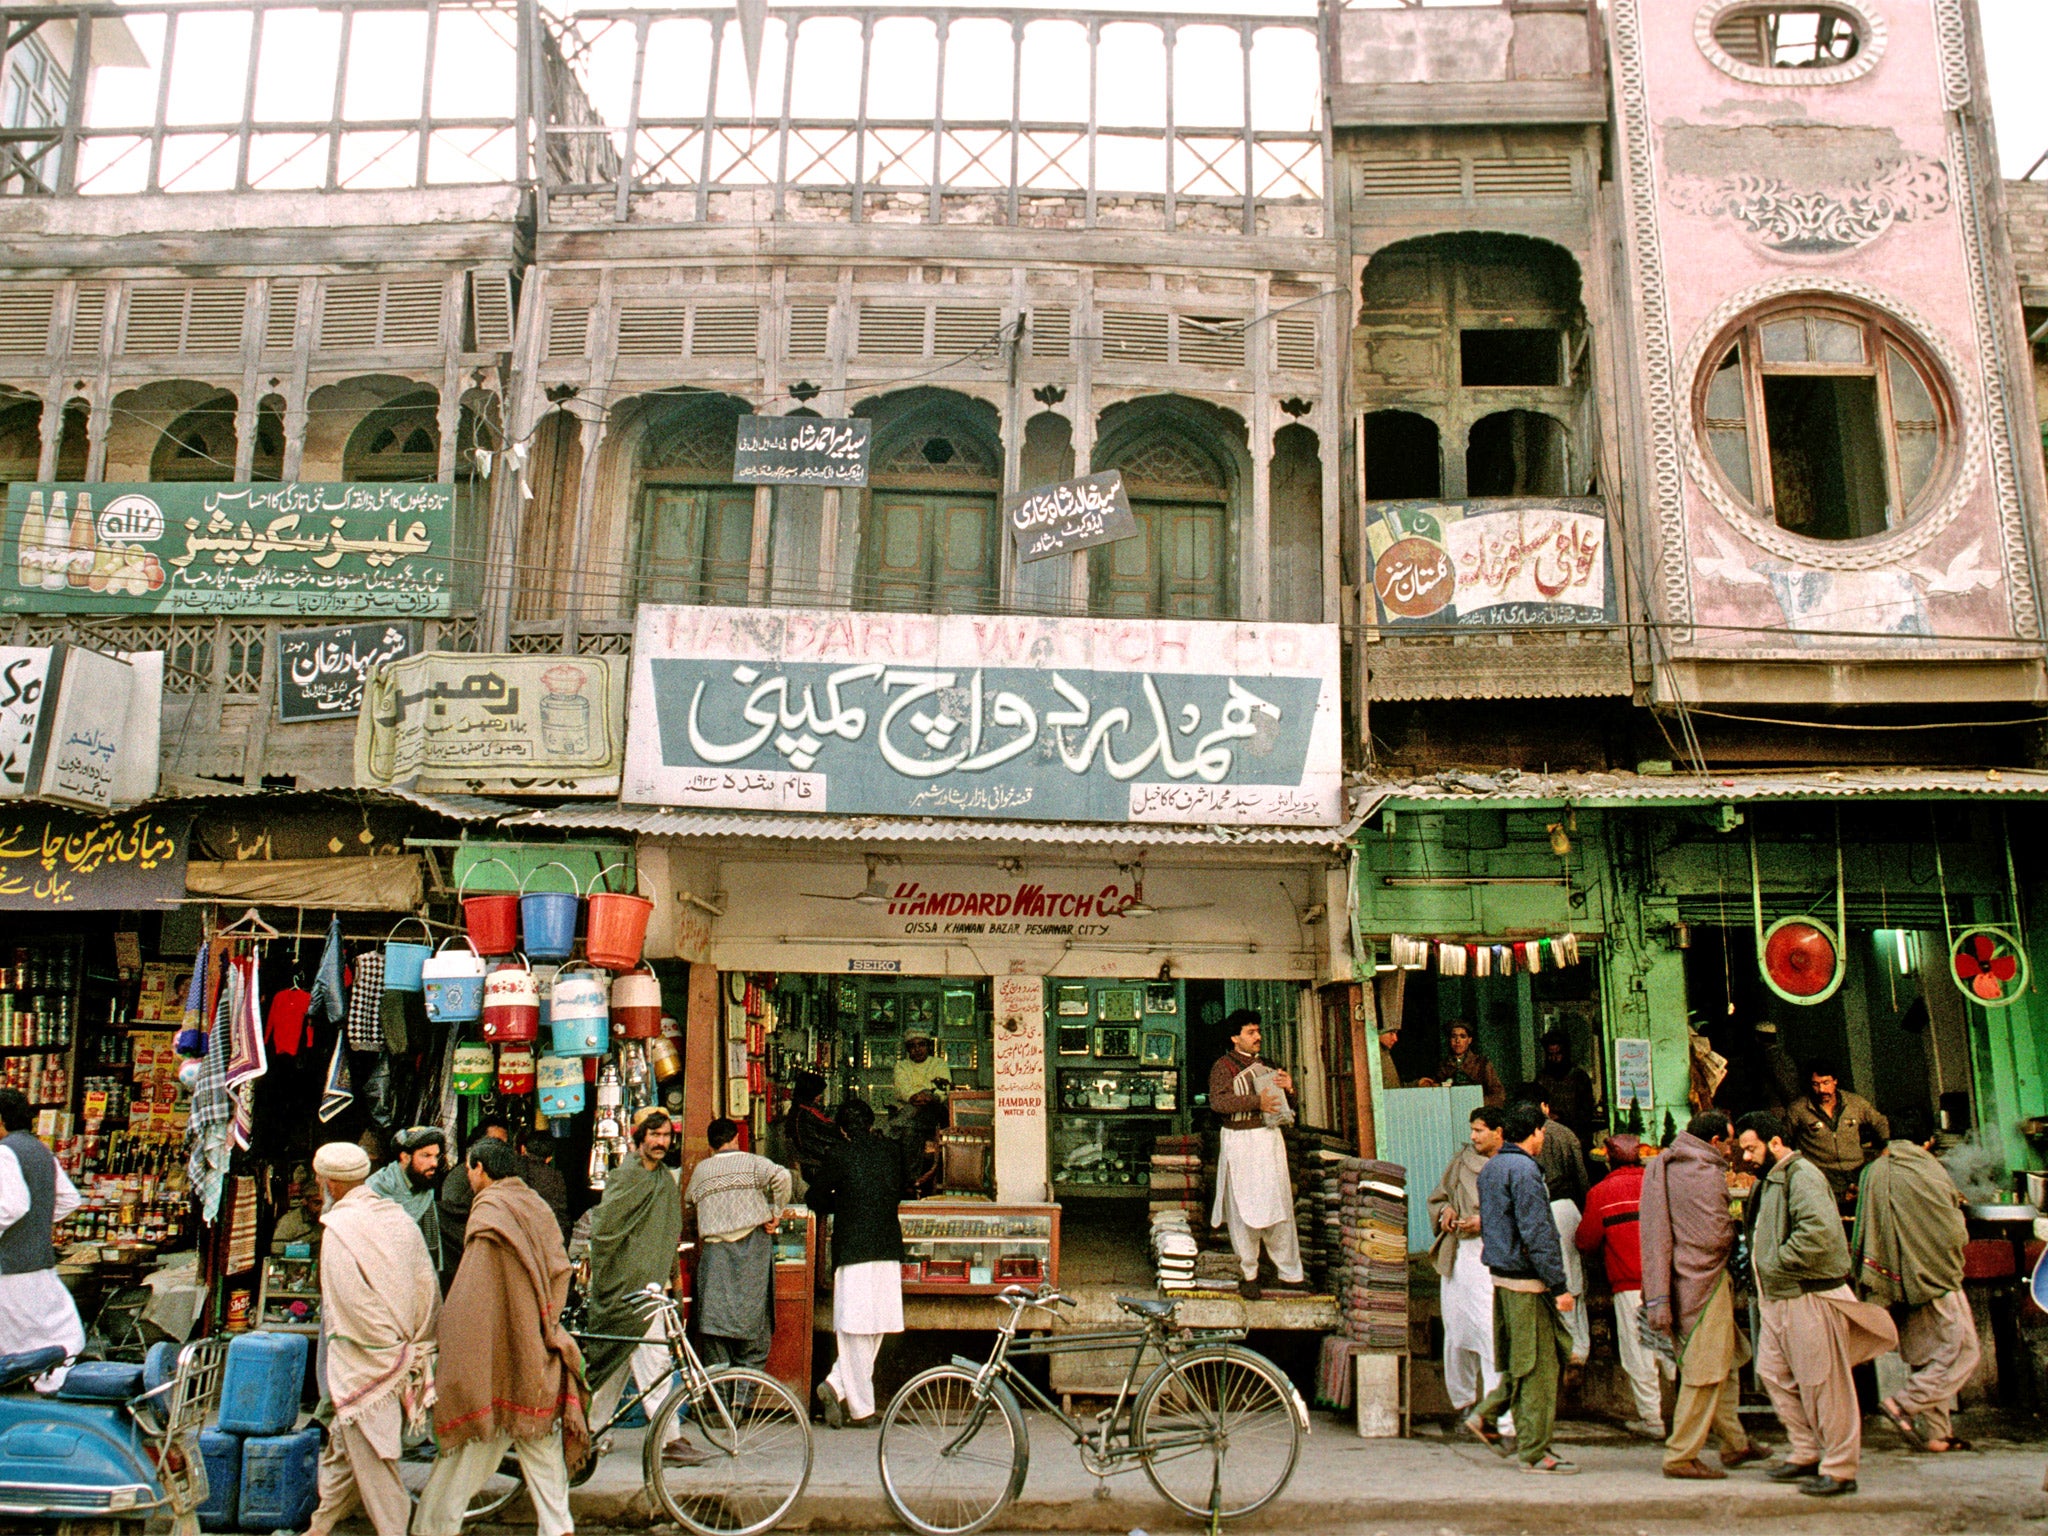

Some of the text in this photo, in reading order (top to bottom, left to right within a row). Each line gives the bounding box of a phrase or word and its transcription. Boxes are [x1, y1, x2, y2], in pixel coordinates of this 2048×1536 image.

[790, 424, 816, 452] شاہ
[838, 435, 866, 459] سید
[203, 488, 271, 512] احساس
[1013, 494, 1052, 529] بخاری
[1047, 486, 1074, 519] شاہ
[1068, 484, 1101, 516] خالد
[1394, 553, 1448, 602] گلستان
[354, 592, 394, 612] سنز
[396, 592, 438, 613] رزاق
[291, 640, 340, 686] خان
[338, 640, 379, 681] بہادر
[687, 662, 1283, 783] ہمدرد واچ کمپنی
[721, 774, 775, 794] شدہ
[1230, 793, 1263, 815] سید
[64, 820, 122, 873] بہترین
[117, 814, 152, 862] کی
[141, 822, 174, 870] دنیا
[34, 871, 74, 904] یہاں
[887, 882, 1012, 917] HAMDARD
[1012, 883, 1093, 917] WATCH
[904, 922, 938, 935] QISSA
[945, 922, 986, 935] KHAWANI
[989, 922, 1020, 935] BAZAR
[1024, 923, 1074, 936] PESHAWAR
[852, 959, 897, 972] SEIKO
[998, 1097, 1042, 1108] HAMDARD
